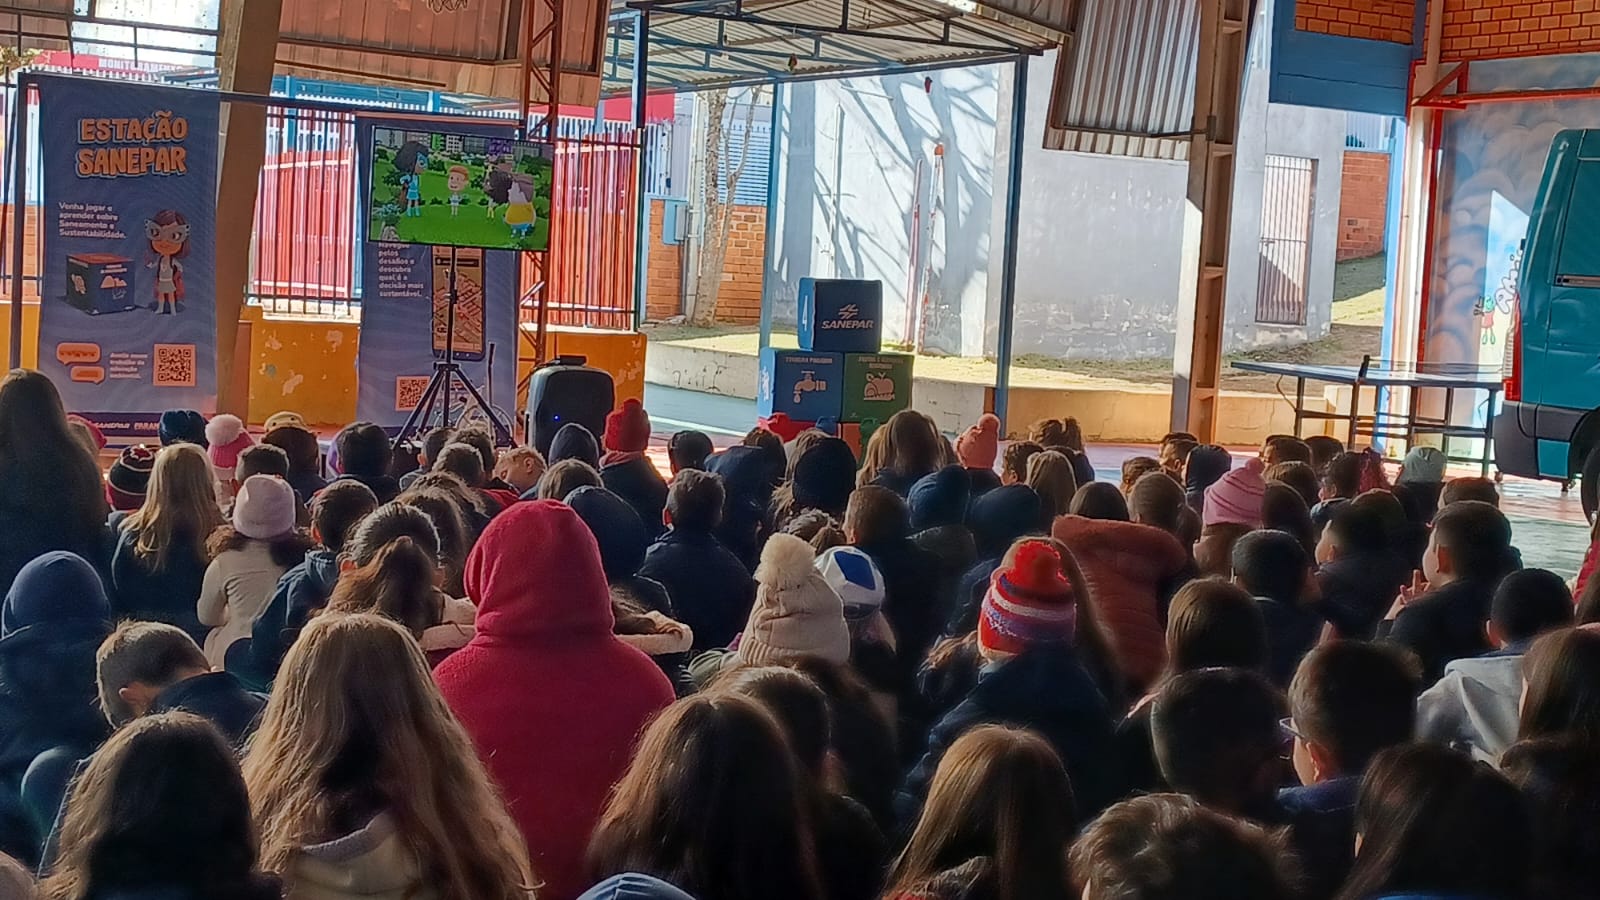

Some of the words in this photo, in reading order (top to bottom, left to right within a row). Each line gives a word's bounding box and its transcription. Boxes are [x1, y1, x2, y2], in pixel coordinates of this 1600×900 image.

[78, 110, 188, 145] ESTAÇÃO
[75, 147, 187, 178] SANEPAR
[85, 203, 106, 212] jogar
[59, 212, 94, 220] aprender
[96, 213, 119, 221] sobre
[59, 220, 108, 228] Saneamento
[59, 228, 127, 239] Sustentabilidade.
[822, 320, 874, 329] SANEPAR
